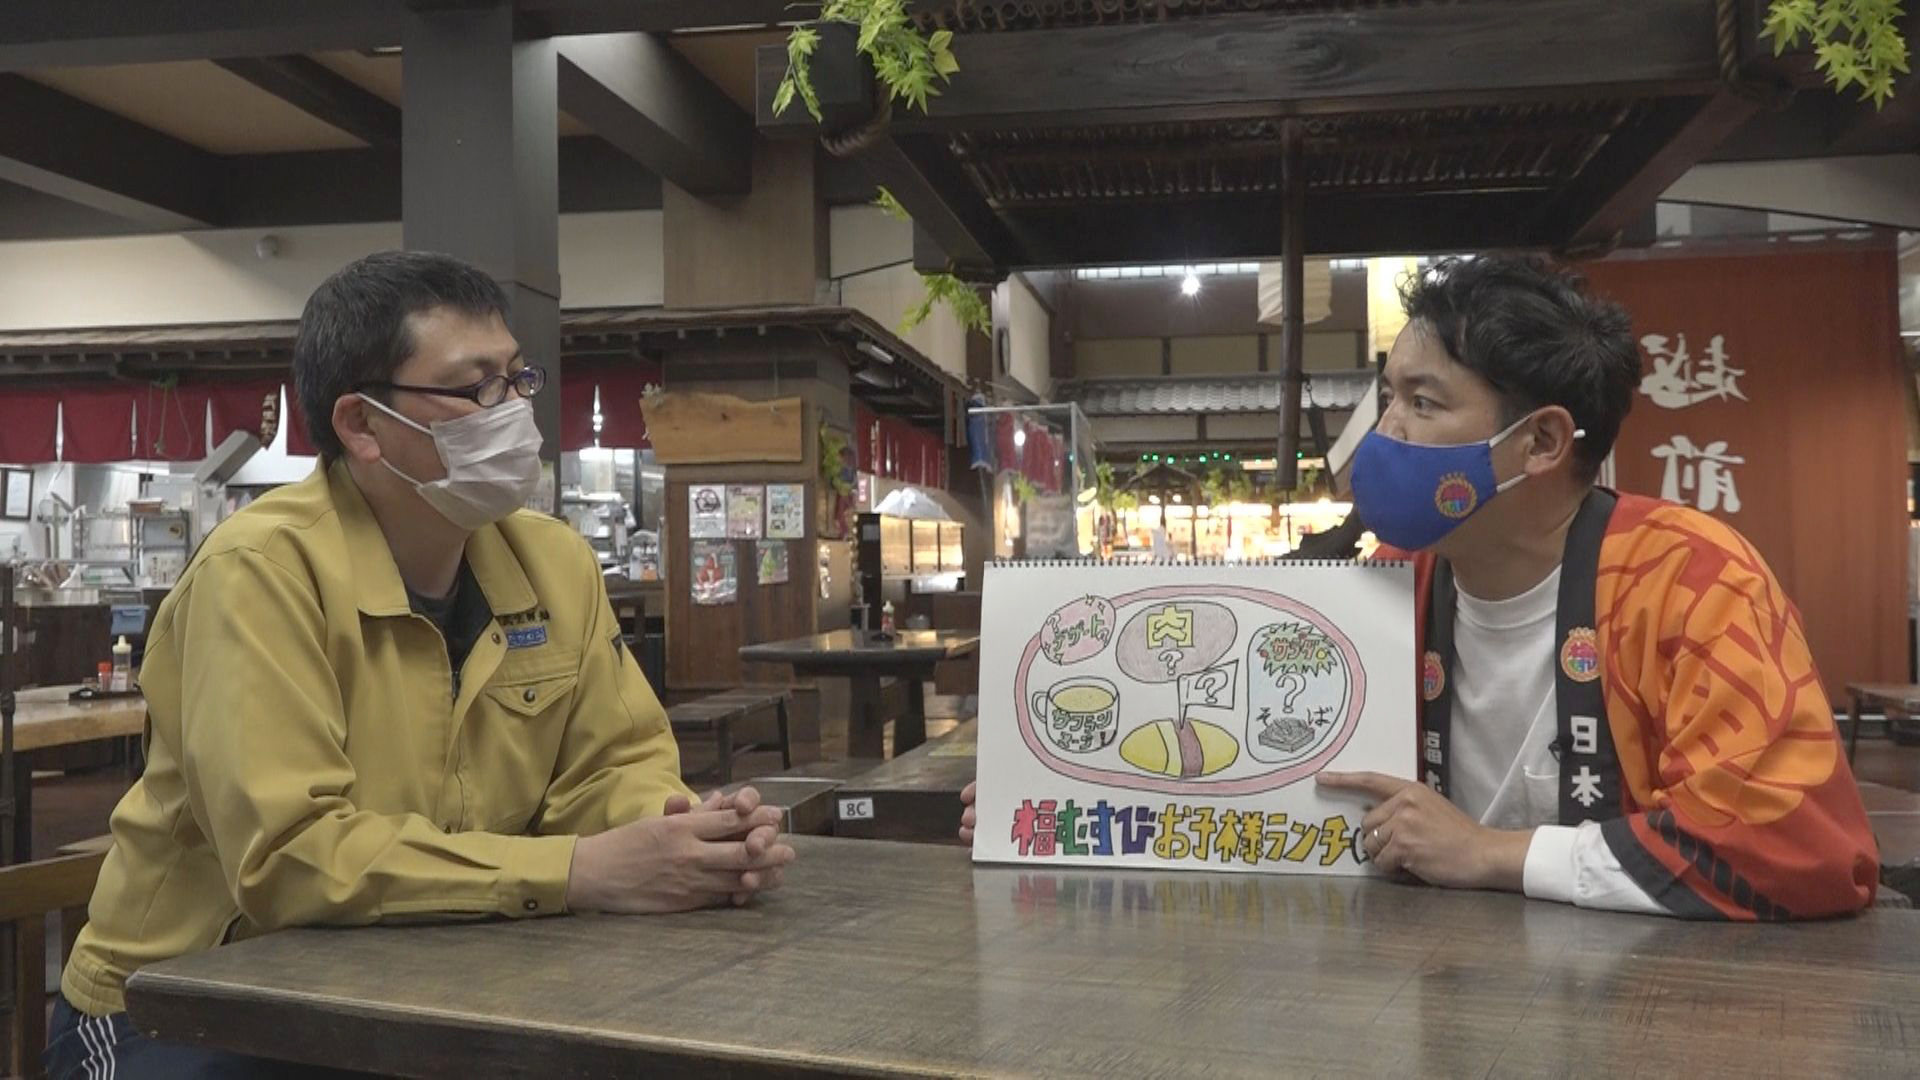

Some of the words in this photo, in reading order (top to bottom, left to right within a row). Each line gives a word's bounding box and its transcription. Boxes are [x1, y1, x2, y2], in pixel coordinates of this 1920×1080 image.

[1146, 604, 1195, 650] 肉
[1272, 637, 1320, 662] サラダ
[1052, 708, 1113, 732] サフラン
[1570, 714, 1604, 808] 日本
[846, 801, 867, 816] 8C
